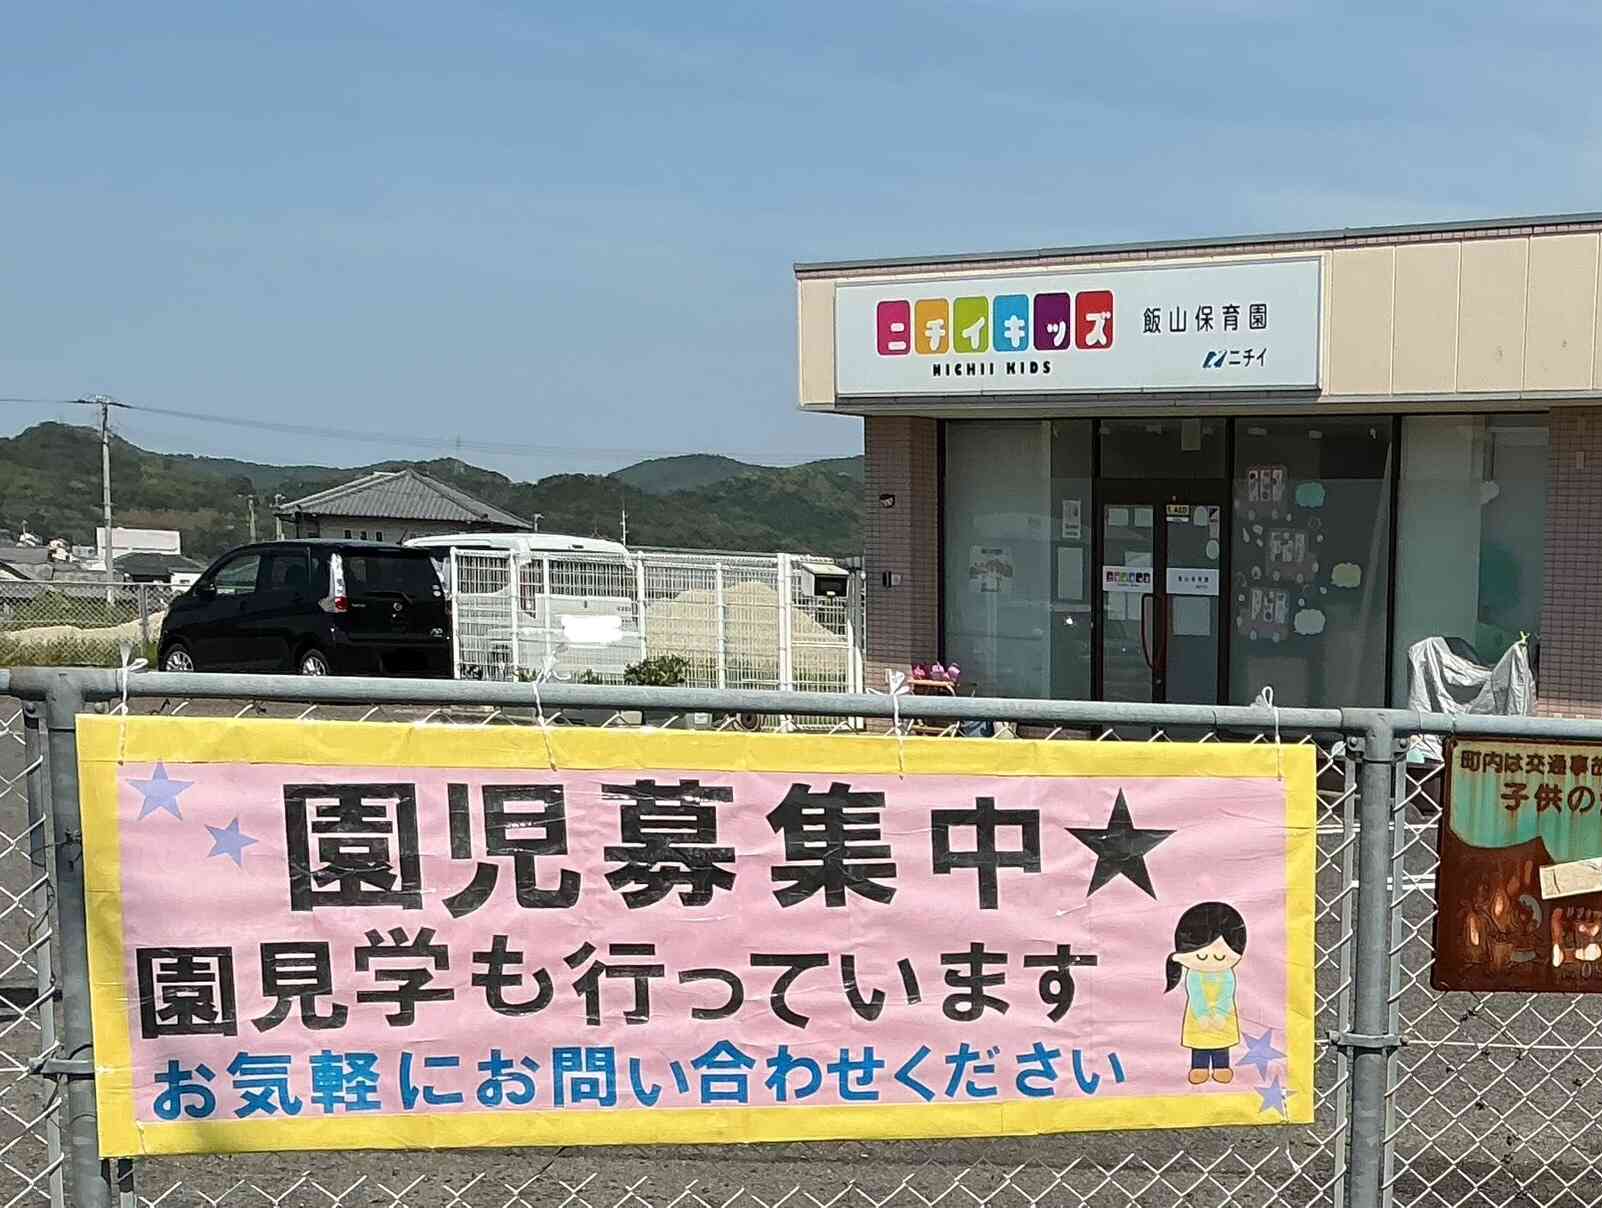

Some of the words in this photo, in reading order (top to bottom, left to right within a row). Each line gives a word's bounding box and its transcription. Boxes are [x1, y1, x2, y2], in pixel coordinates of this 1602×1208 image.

[884, 308, 1112, 352] ニチイキッズ
[1143, 303, 1267, 334] 飯山保育園
[932, 362, 994, 377] NICHII
[1006, 361, 1052, 375] KIDS
[1228, 348, 1267, 367] ニチイ
[135, 927, 1101, 1041] 園見学も行っています
[152, 1038, 1126, 1120] お気軽にお問い合わせください
